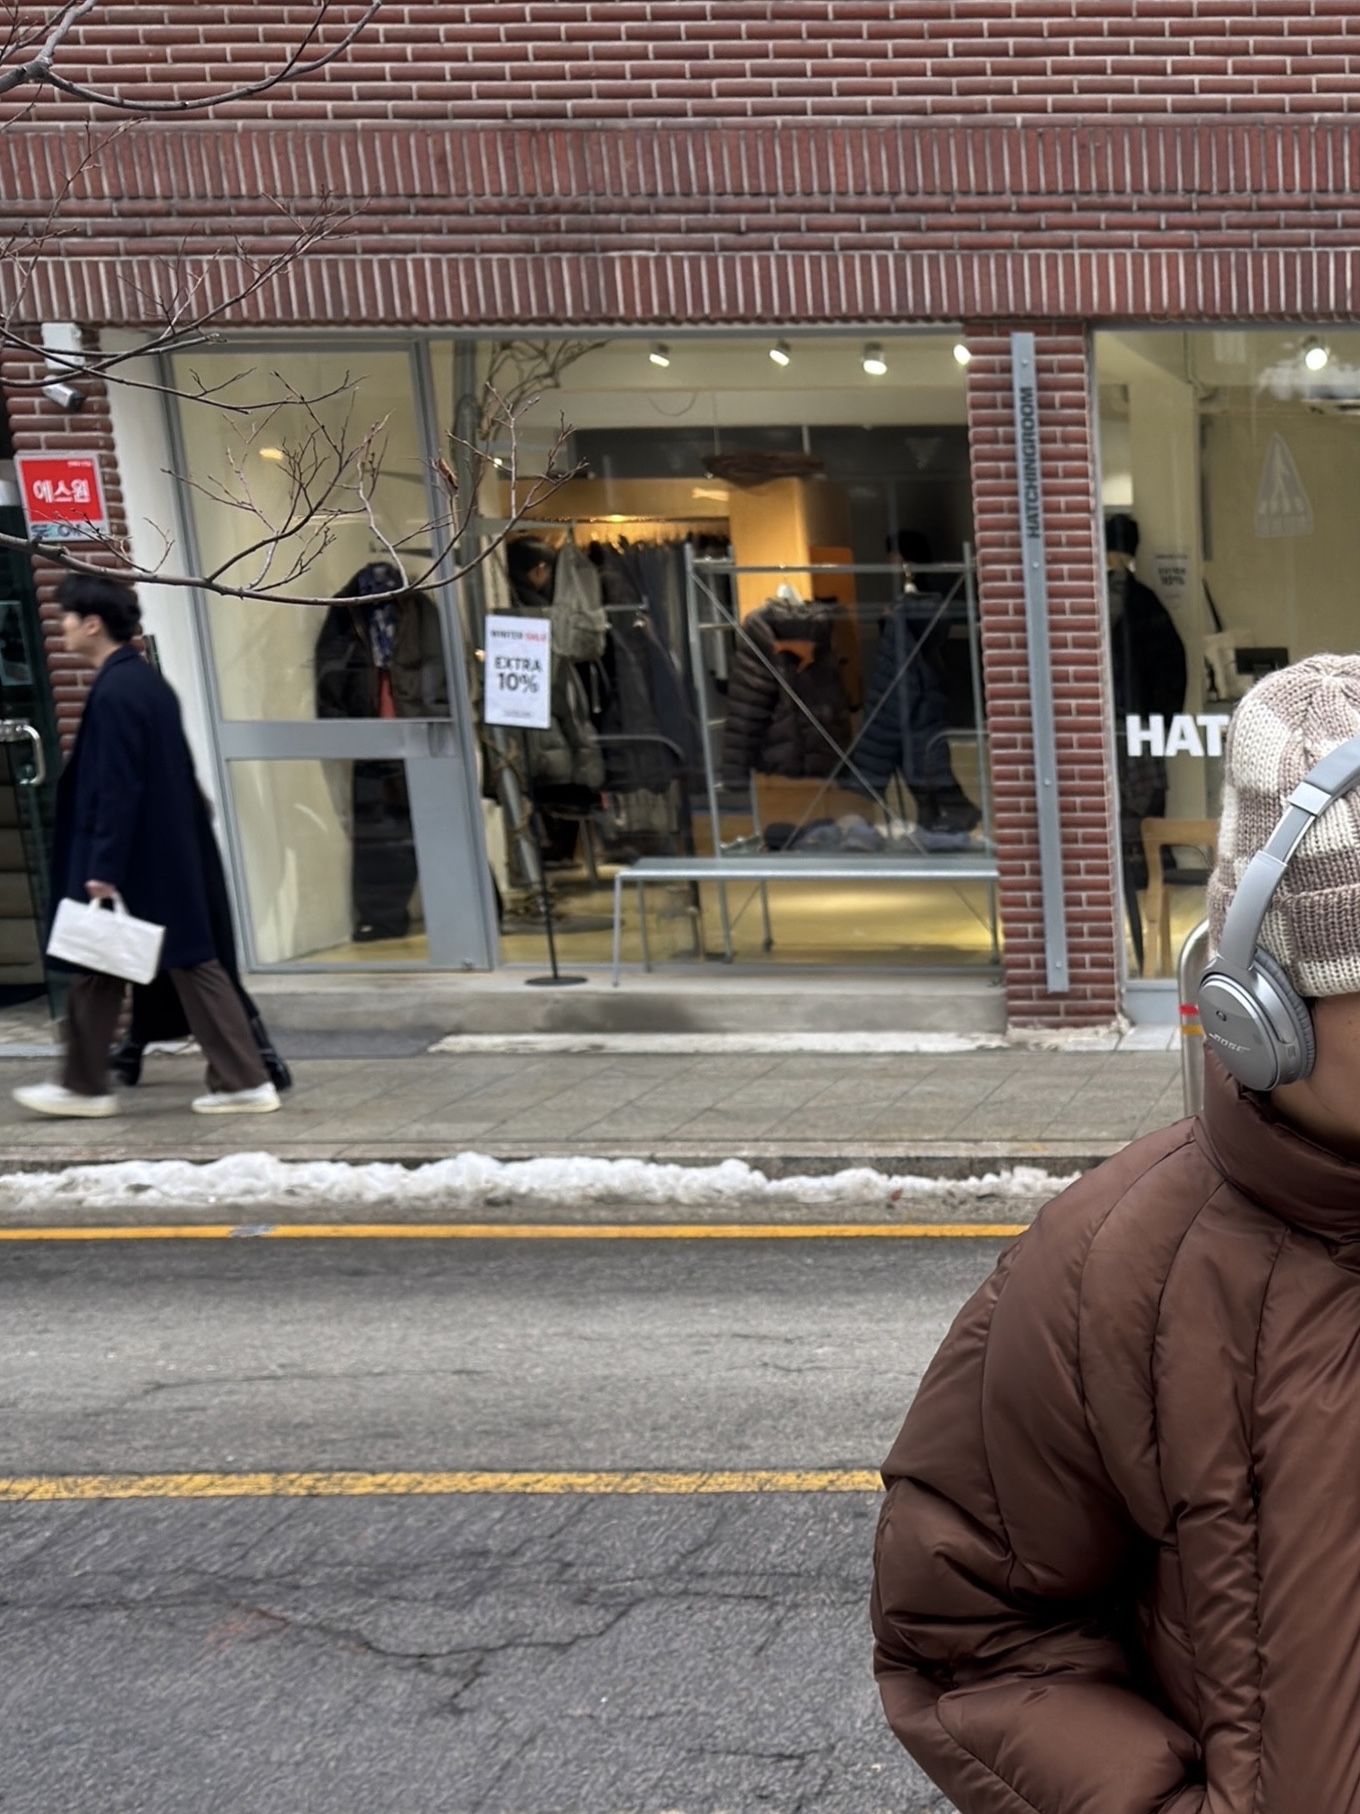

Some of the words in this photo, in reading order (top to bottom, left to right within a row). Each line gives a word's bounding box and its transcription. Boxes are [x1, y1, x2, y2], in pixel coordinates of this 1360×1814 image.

[1019, 386, 1041, 540] HATCHINGROOM
[32, 478, 91, 504] 에스원
[494, 657, 543, 672] EXTRA
[498, 672, 540, 694] 10%
[1125, 713, 1231, 758] HAT
[1208, 1032, 1251, 1054] BOSE
